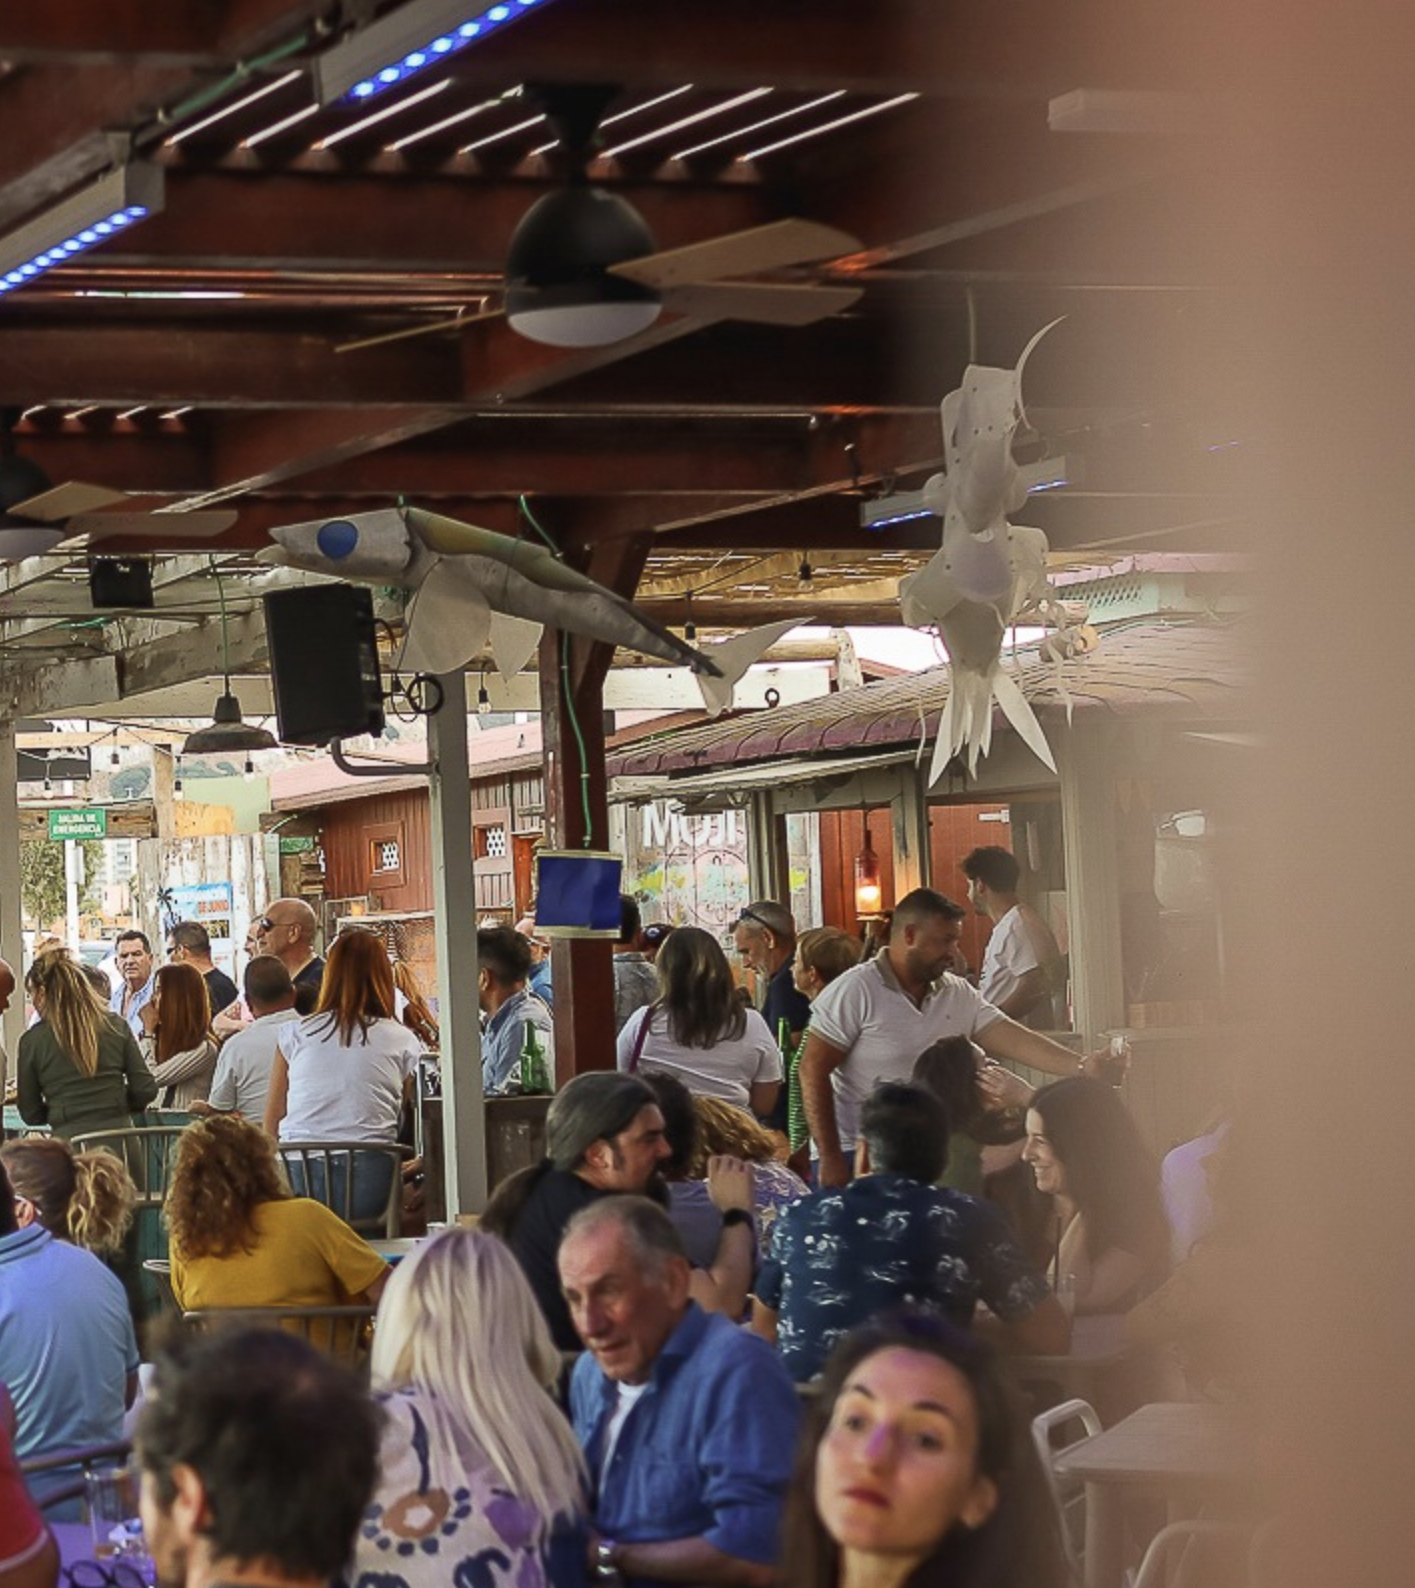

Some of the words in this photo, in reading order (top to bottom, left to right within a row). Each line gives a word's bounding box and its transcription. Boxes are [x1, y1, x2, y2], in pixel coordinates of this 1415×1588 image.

[58, 813, 85, 823] SALIDA
[86, 813, 96, 823] DE
[52, 824, 102, 834] EMERGENCIA
